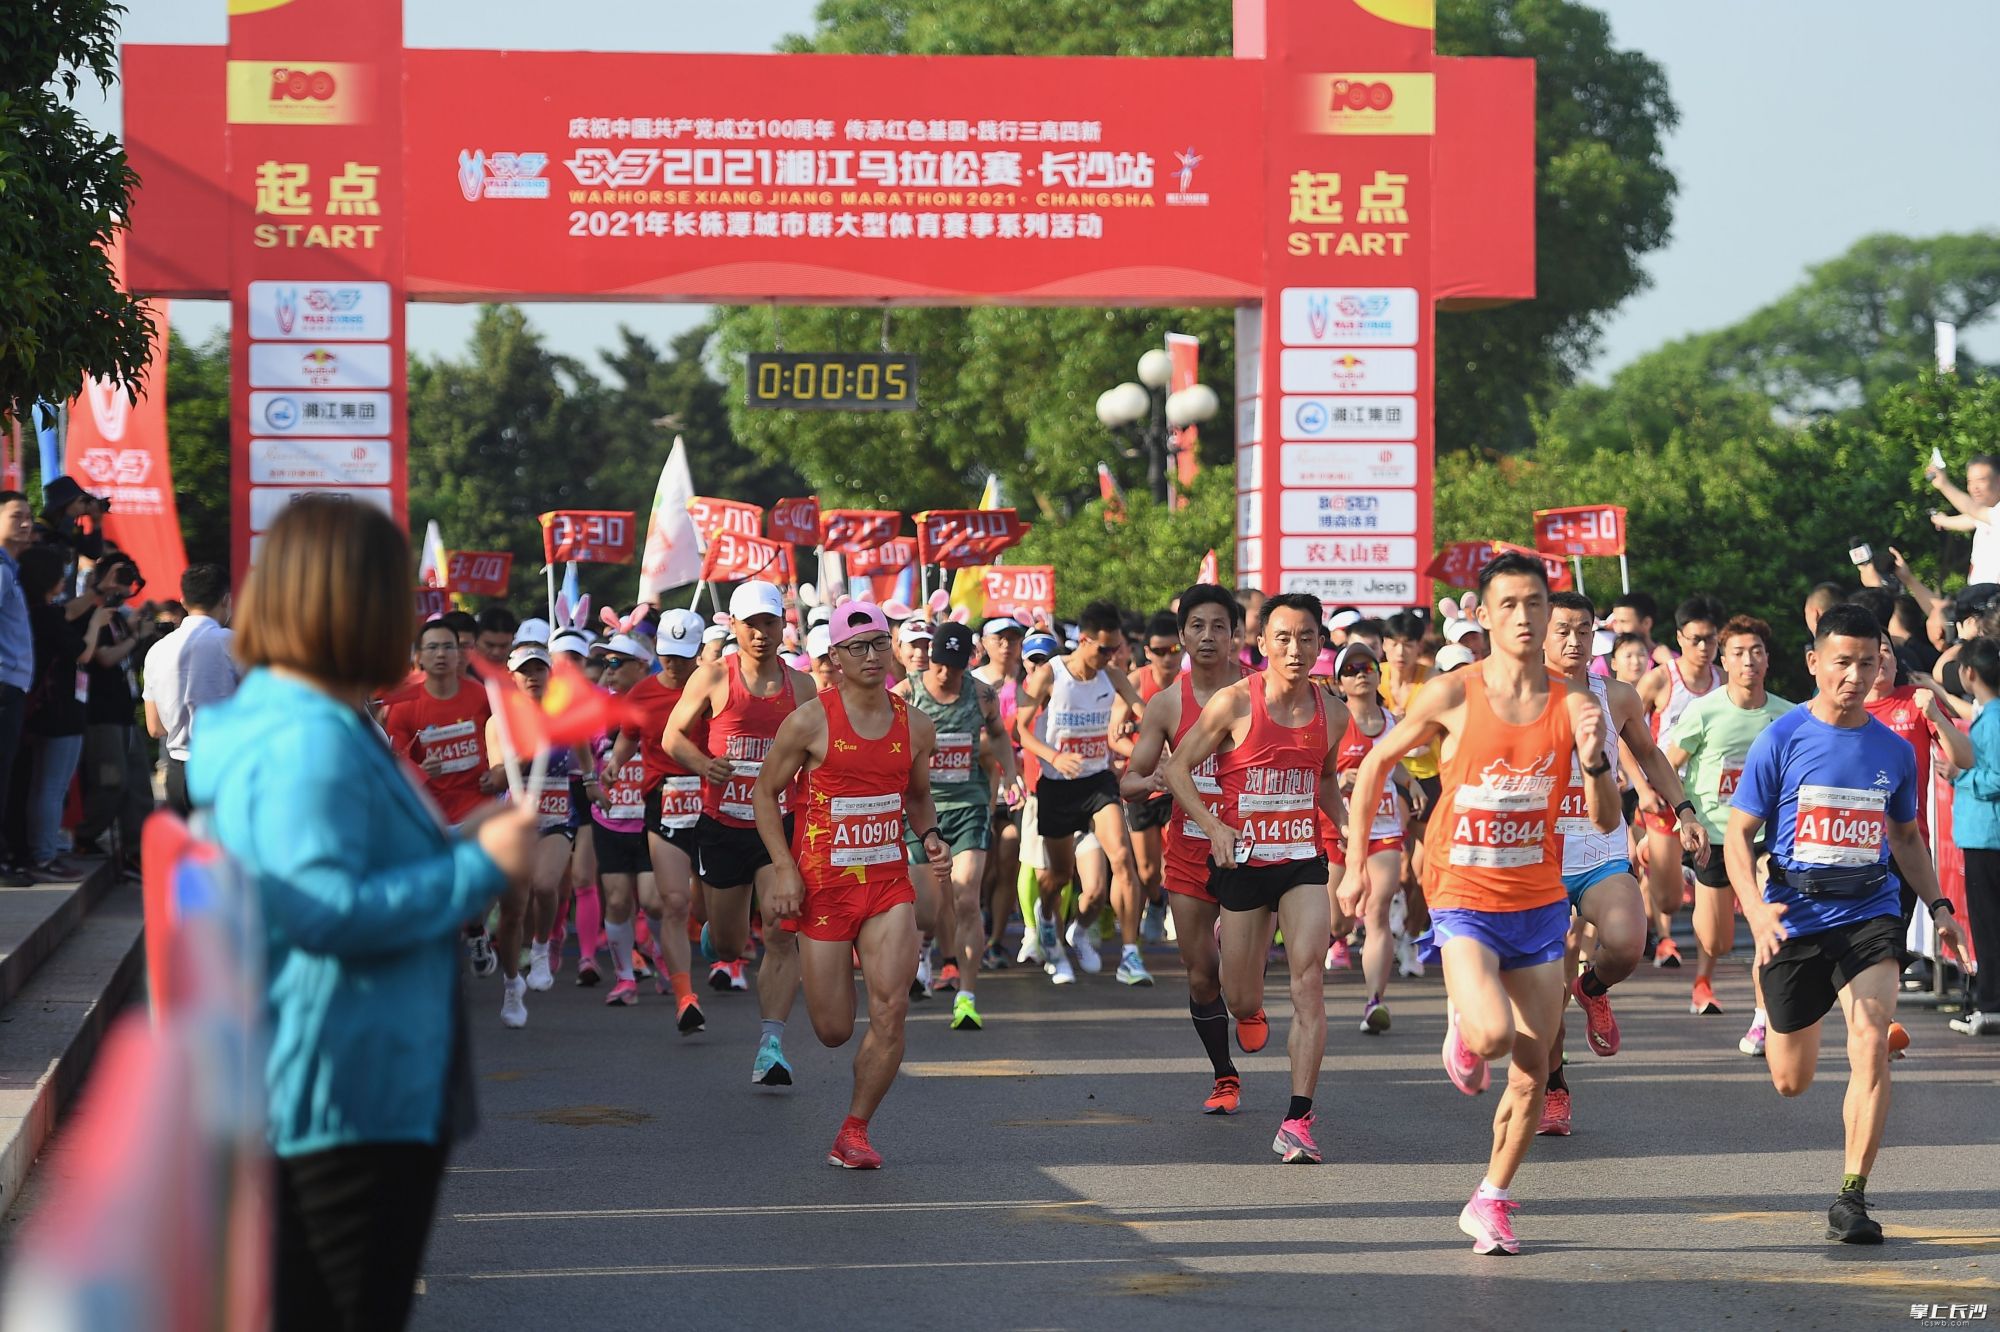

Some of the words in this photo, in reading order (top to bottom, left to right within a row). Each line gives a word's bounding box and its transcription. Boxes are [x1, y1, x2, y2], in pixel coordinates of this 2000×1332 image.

[568, 117, 836, 140] 庆祝中国共产党成立100周年
[255, 160, 381, 216] 起点
[568, 190, 691, 205] WARHORSE
[695, 191, 763, 206] XIANG
[767, 191, 834, 206] JIANG
[841, 192, 961, 207] MARATHON
[966, 192, 1016, 207] 2021
[1035, 193, 1156, 208] CHANGSHA
[1288, 169, 1409, 224] 起点
[253, 223, 383, 249] START
[568, 210, 1103, 239] 2021年长株潭城市群大型体育赛事系列活动
[1287, 231, 1411, 257] START
[758, 362, 907, 400] 0:00:05
[553, 517, 624, 545] 2:30
[1546, 511, 1617, 541] 2:30
[450, 556, 504, 581] 3:00
[986, 573, 1048, 600] 2:00
[1364, 580, 1407, 594] Jeep
[608, 788, 643, 804] 3:00
[833, 819, 899, 846] A10910
[1242, 818, 1313, 840] A14166
[1454, 816, 1545, 844] A13844
[1798, 814, 1882, 846] A10493
